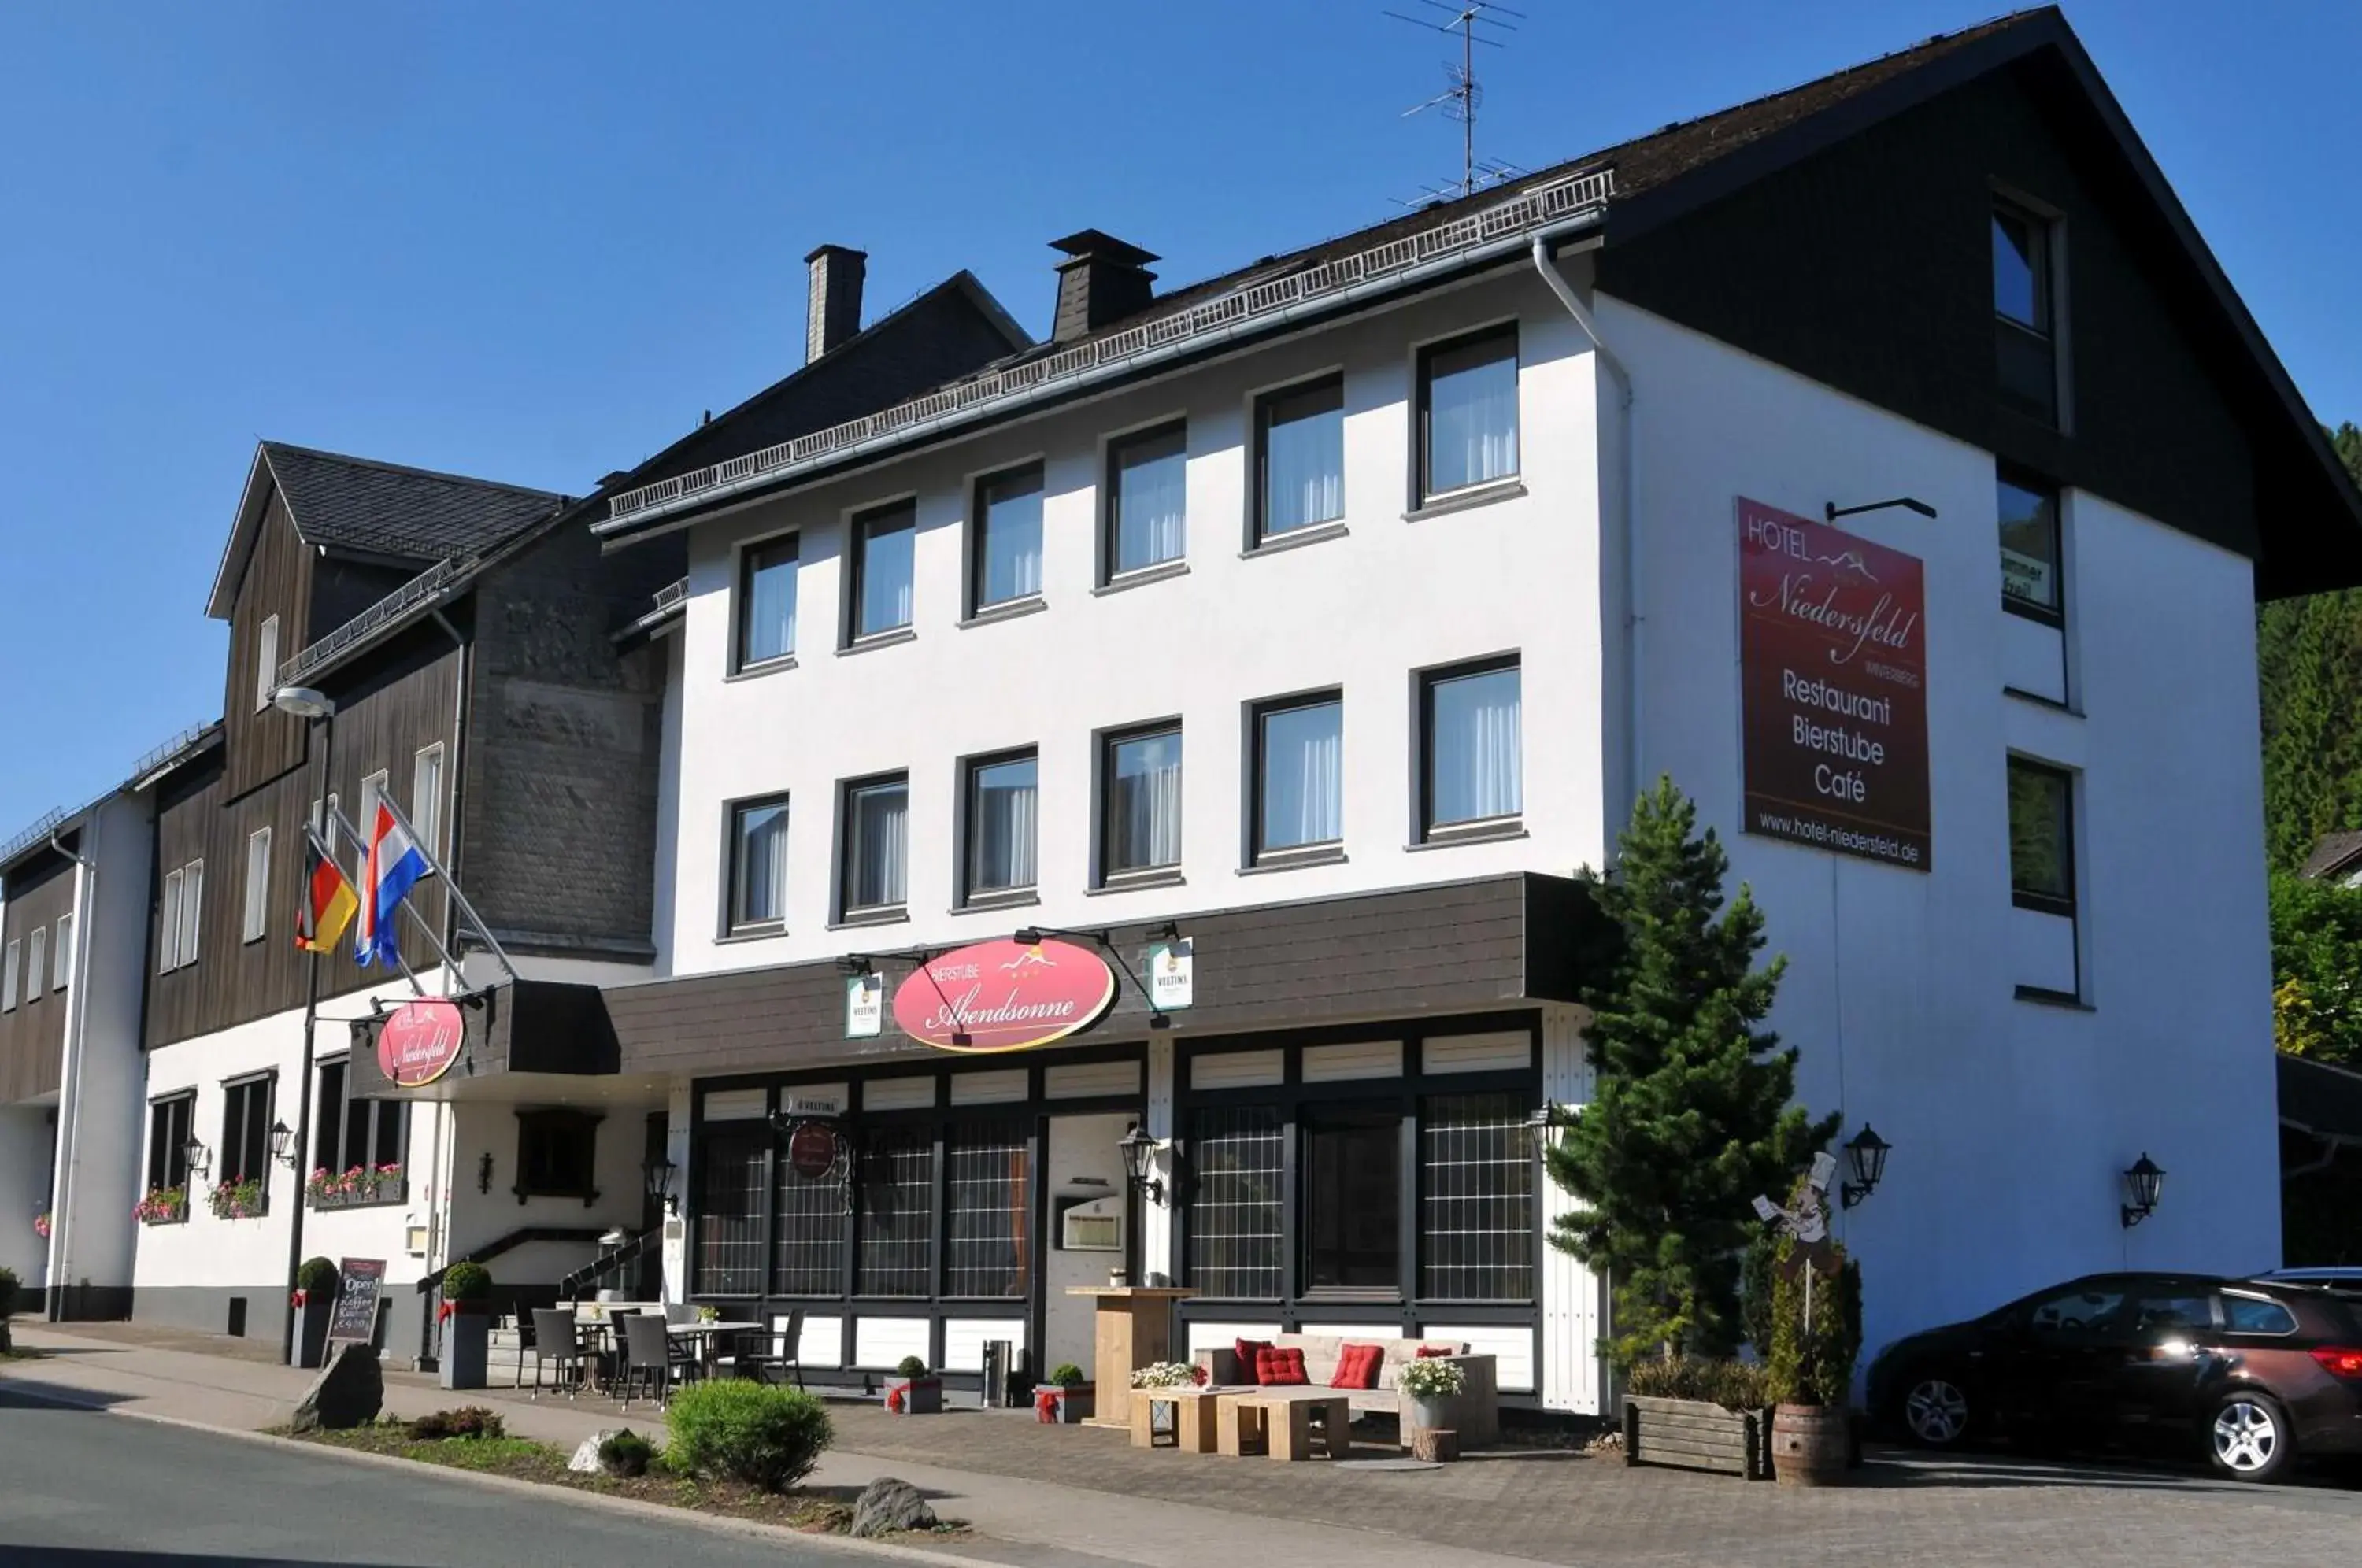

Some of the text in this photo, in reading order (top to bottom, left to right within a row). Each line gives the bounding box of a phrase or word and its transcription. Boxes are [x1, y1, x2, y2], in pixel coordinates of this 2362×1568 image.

[1748, 514, 1812, 562] HOTEL
[1749, 572, 1918, 664] Niedersfeld
[1783, 668, 1890, 726] Restaurant
[1793, 714, 1885, 765] Bierstube
[1814, 764, 1866, 803] Café
[1759, 812, 1919, 862] www.hotel-niedersfeld.de
[925, 982, 1075, 1030] Abendsonne
